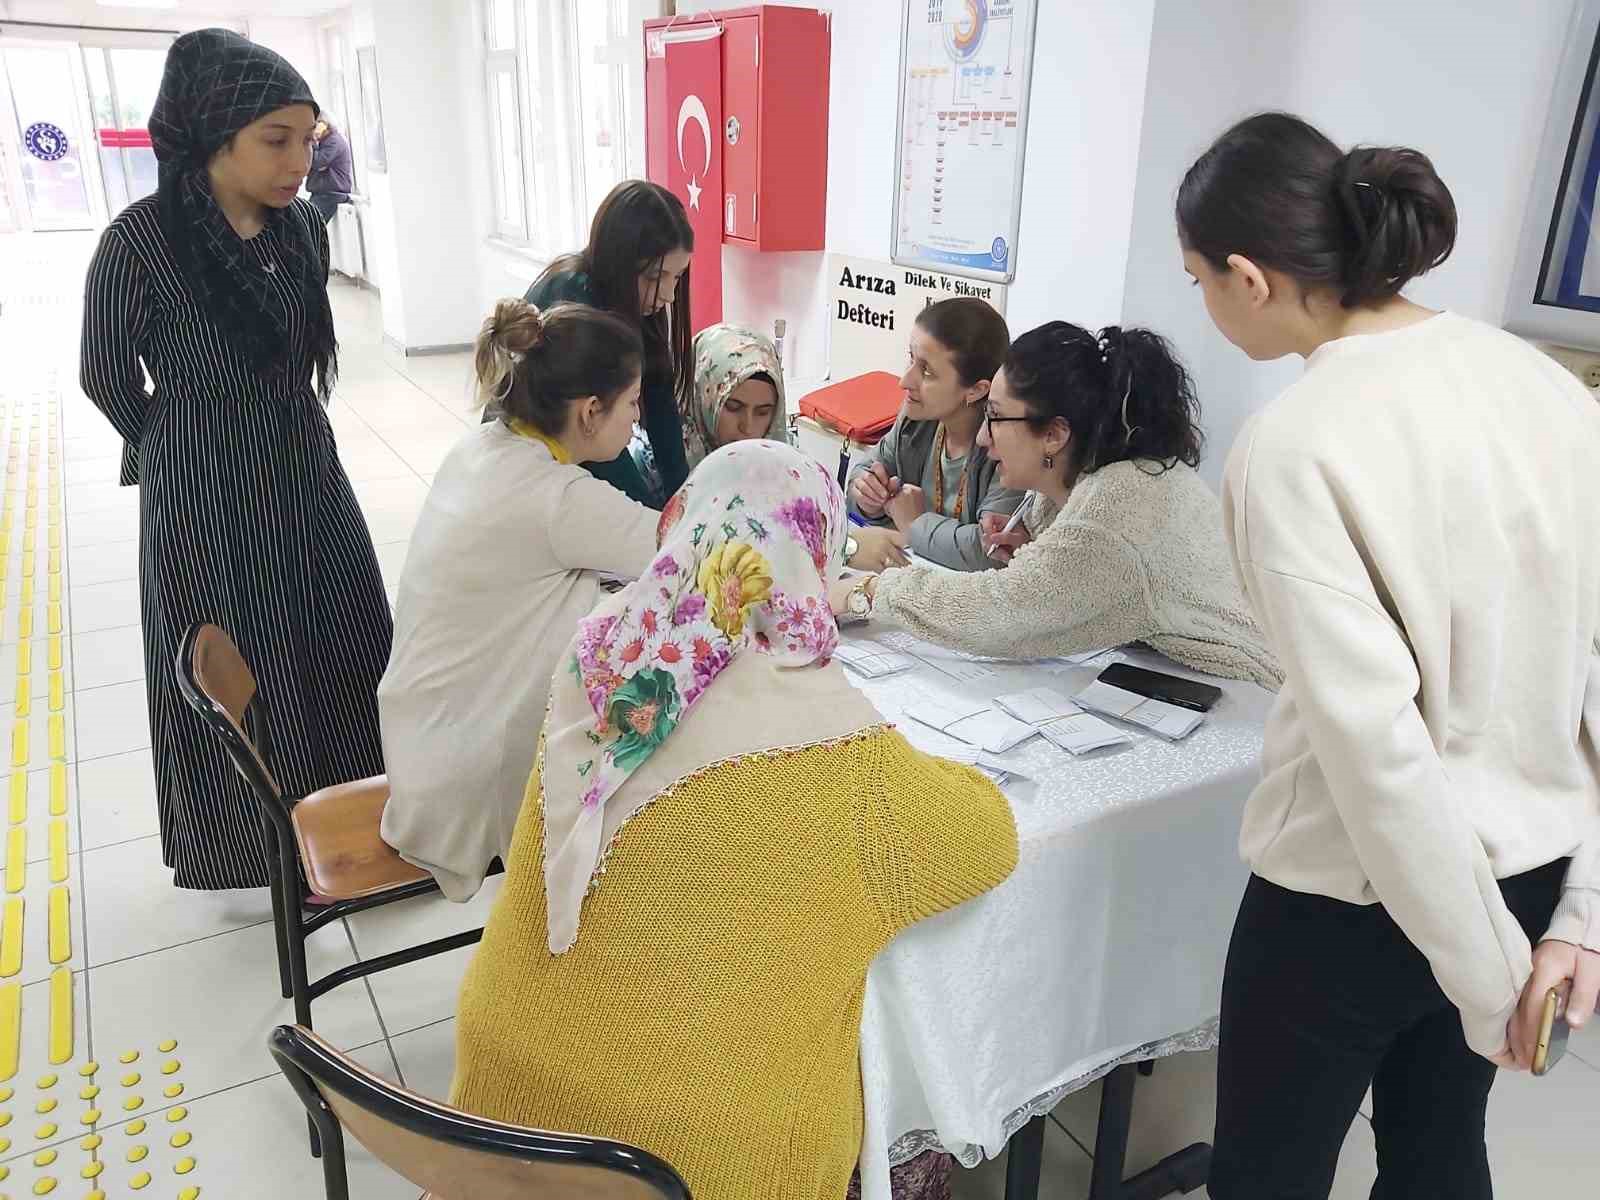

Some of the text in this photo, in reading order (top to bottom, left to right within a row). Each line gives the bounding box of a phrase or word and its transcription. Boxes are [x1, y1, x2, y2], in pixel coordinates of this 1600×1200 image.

[839, 266, 896, 296] Arıza
[904, 271, 937, 289] Dilek
[940, 276, 952, 291] Ve
[837, 299, 895, 330] Defteri
